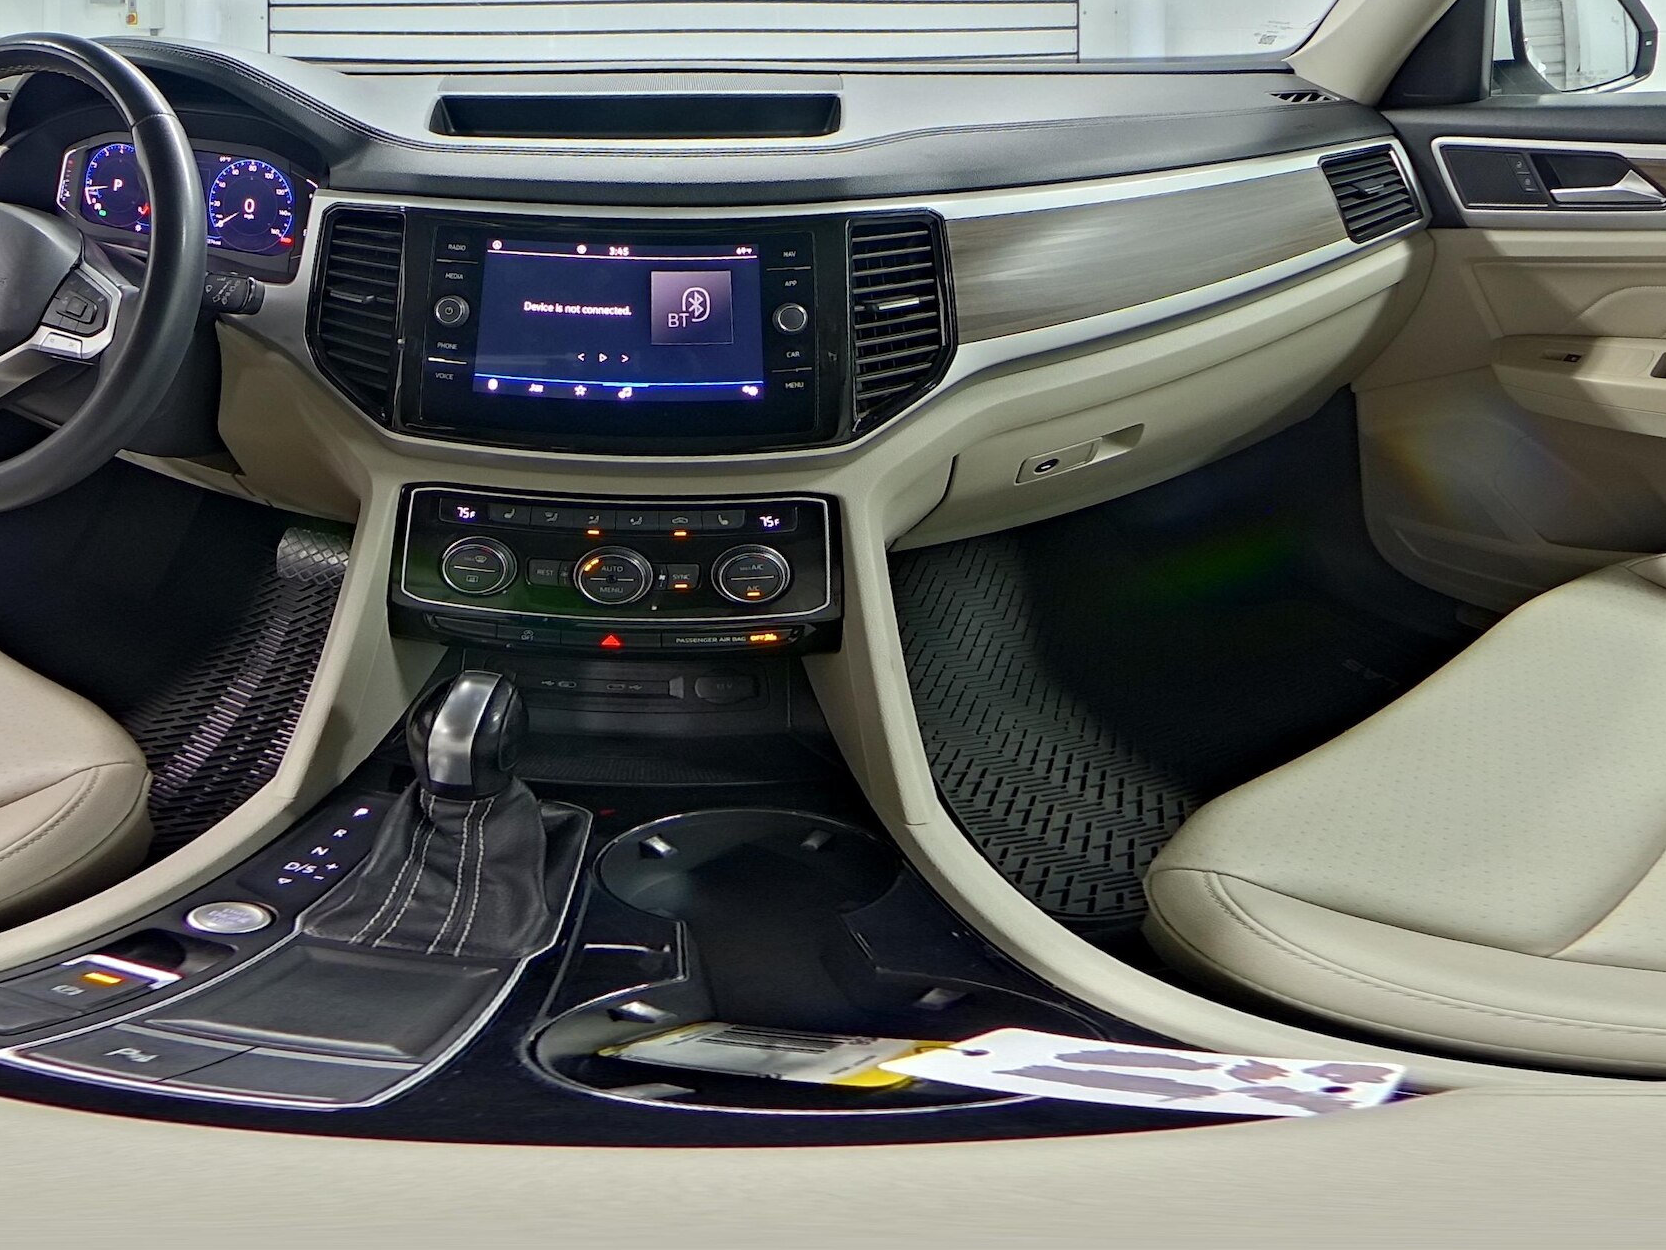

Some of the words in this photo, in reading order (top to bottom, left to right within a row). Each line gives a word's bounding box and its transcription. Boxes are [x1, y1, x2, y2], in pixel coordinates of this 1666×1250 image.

[113, 179, 123, 191] P
[244, 199, 255, 213] 0
[609, 247, 629, 256] 3:45
[445, 272, 463, 280] MEDIA
[524, 301, 554, 313] Device
[555, 303, 563, 313] is
[565, 304, 580, 314] not
[582, 304, 632, 316] connected.
[668, 313, 689, 328] BT
[437, 342, 458, 350] PHONE
[435, 372, 454, 380] VOICE
[601, 565, 623, 573] AUTO
[600, 586, 623, 594] MENU
[333, 829, 347, 837] R
[311, 847, 329, 855] N
[283, 862, 317, 874] D/S
